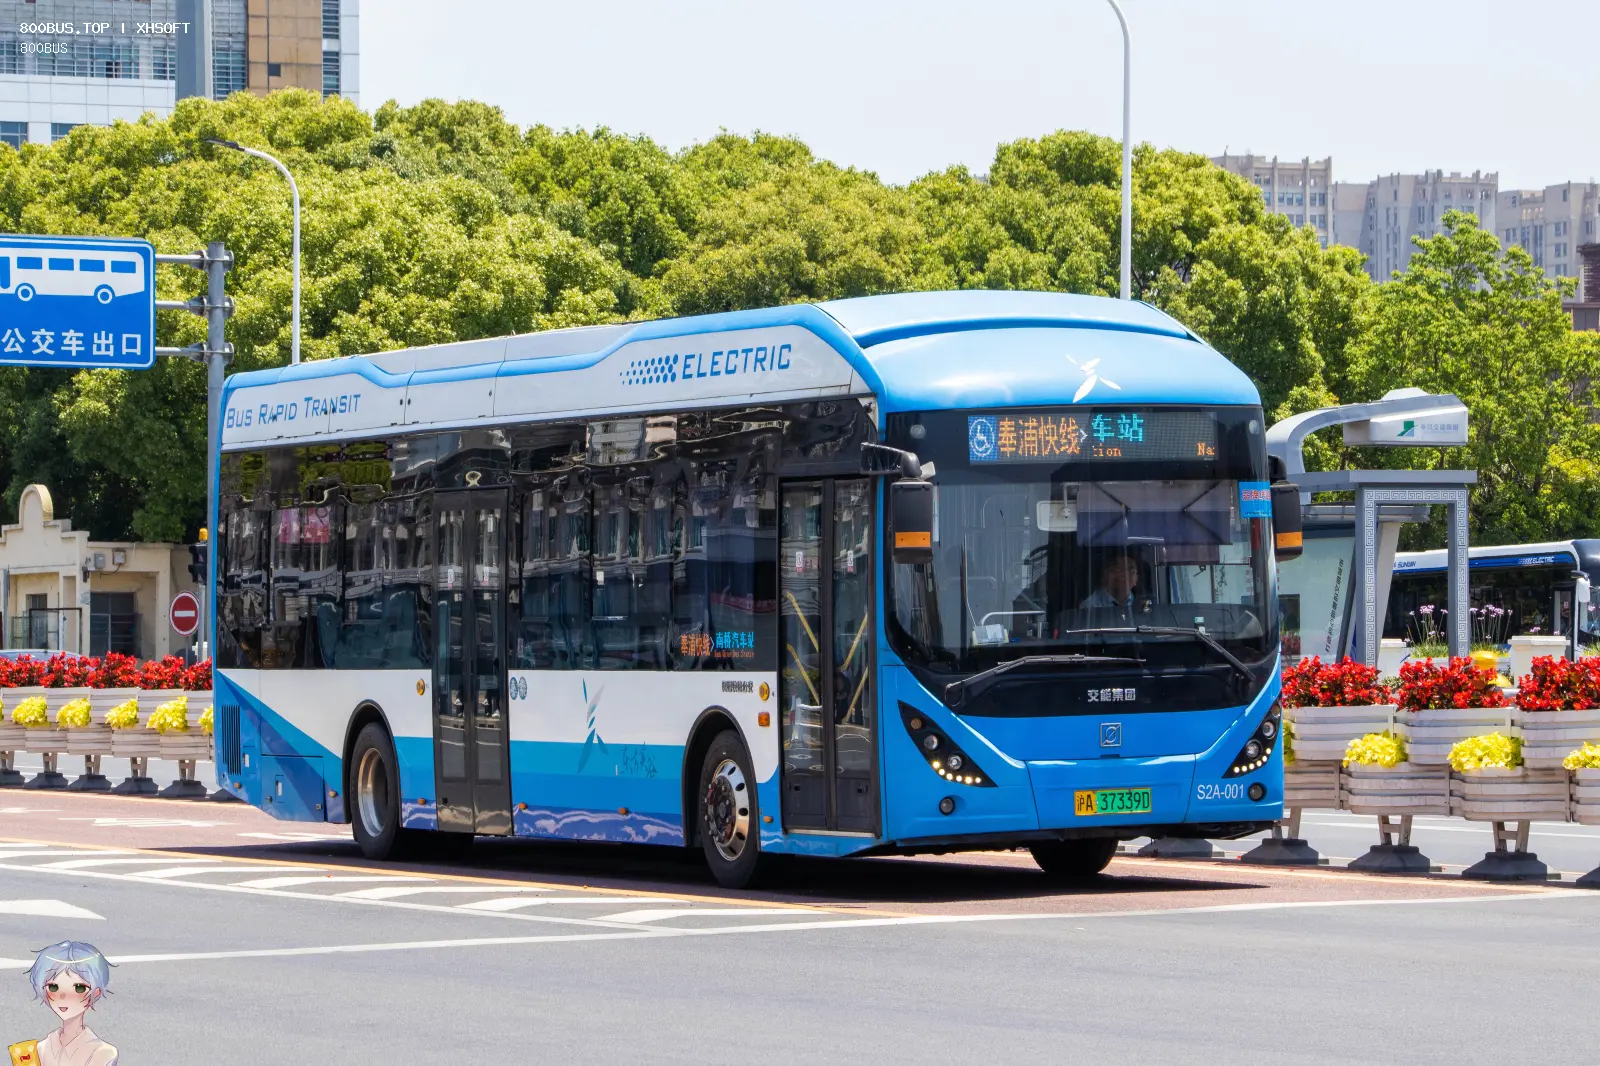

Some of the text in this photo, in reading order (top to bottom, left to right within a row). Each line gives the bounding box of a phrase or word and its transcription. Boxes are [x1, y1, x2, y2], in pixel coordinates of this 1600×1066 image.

[1, 328, 141, 357] 公交车出口
[682, 344, 791, 379] ELECTRIC
[997, 416, 1081, 457] 奉浦快线
[1091, 413, 1144, 442] 车站
[715, 631, 754, 649] 南桥汽车站
[1087, 688, 1136, 702] 交能集团
[1197, 784, 1244, 800] S2A-001
